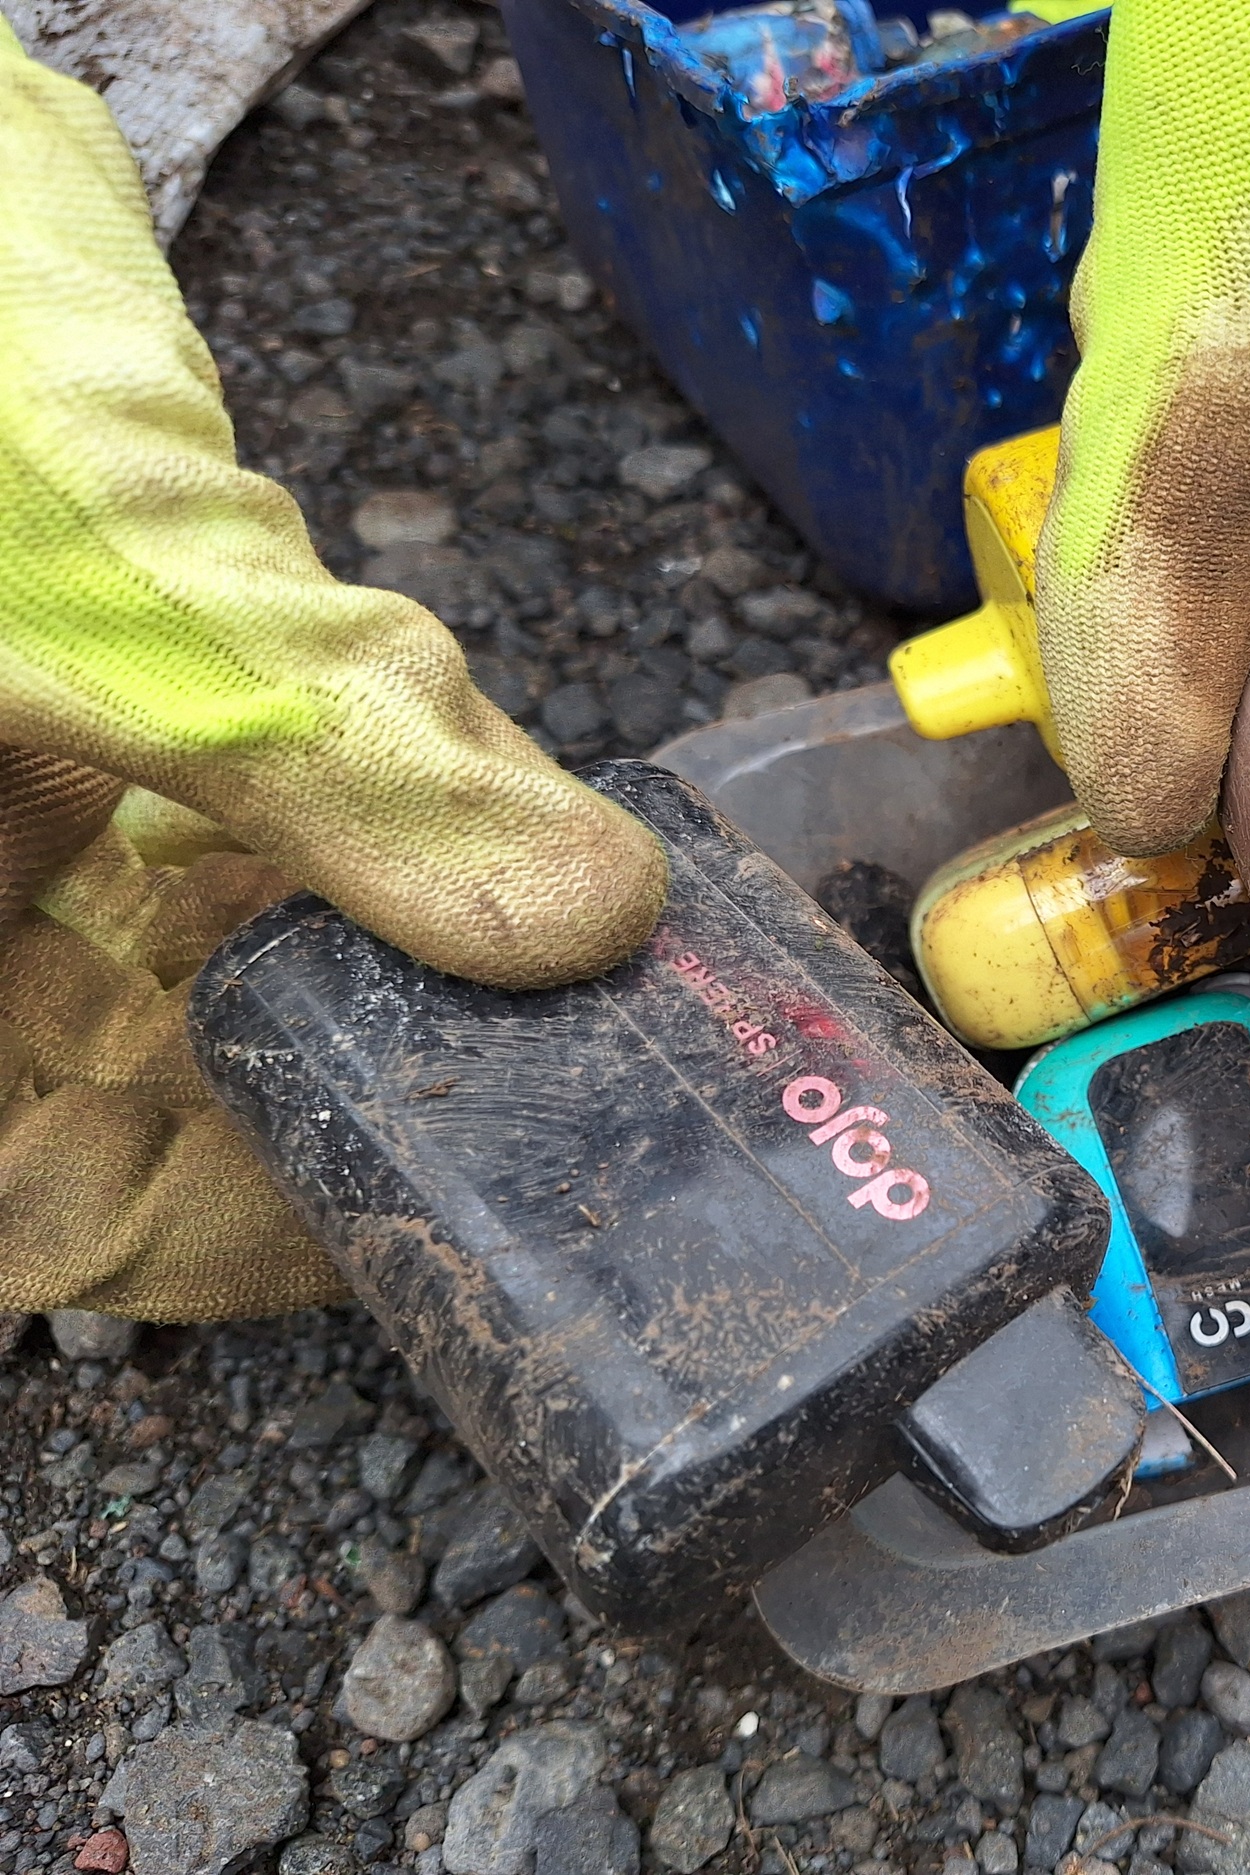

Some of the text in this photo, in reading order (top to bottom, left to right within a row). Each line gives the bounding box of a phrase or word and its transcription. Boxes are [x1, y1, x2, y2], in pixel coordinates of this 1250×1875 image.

[670, 951, 777, 1056] SPERE
[782, 1075, 931, 1221] dojo
[1191, 1277, 1242, 1302] MESH
